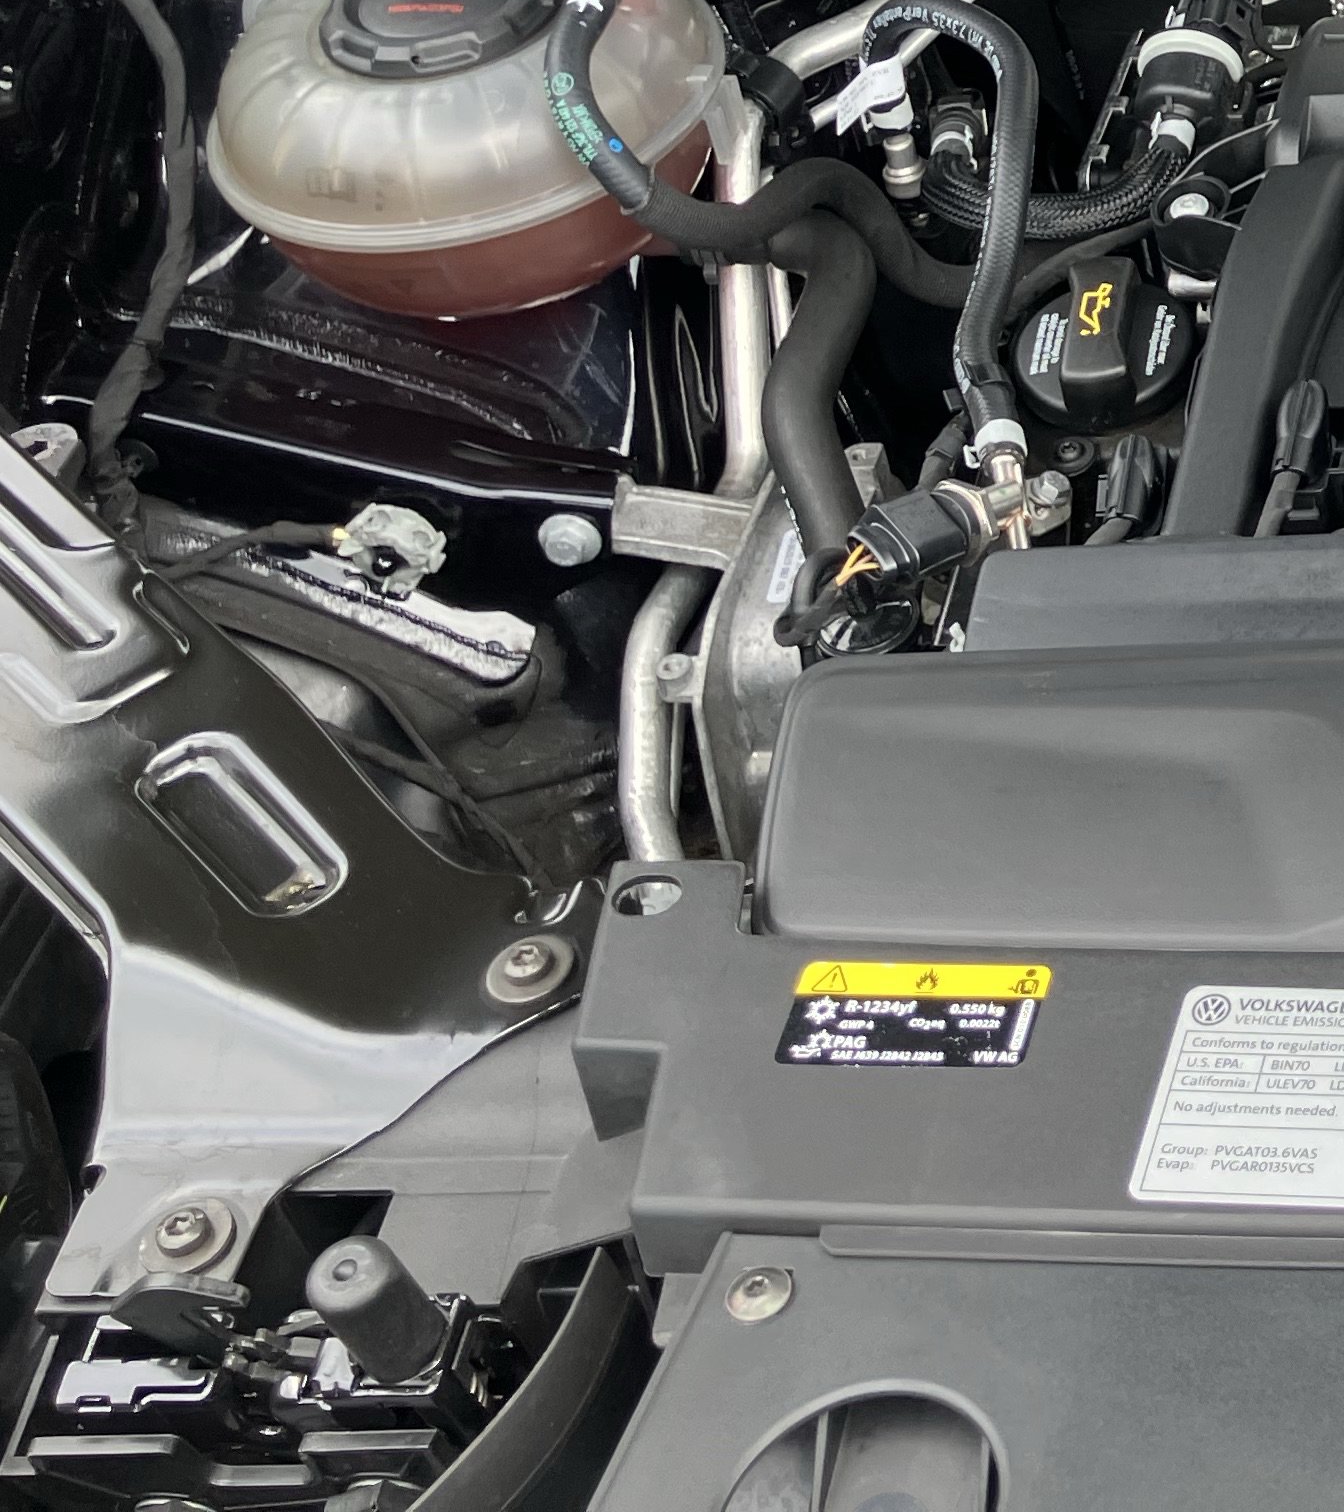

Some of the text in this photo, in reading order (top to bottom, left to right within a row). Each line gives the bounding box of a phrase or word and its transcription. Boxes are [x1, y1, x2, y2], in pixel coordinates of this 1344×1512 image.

[844, 999, 918, 1016] R-1234yf
[949, 1001, 1006, 1017] 0.550 kg
[1235, 1014, 1289, 1026] VEHICLE
[833, 1035, 867, 1048] PAG
[1192, 1037, 1256, 1049] Conforms
[1261, 1039, 1274, 1050] to
[973, 1051, 1018, 1064] VW AG
[1186, 1057, 1243, 1069] U.S. EPA:
[1270, 1060, 1311, 1071] BIN70
[1180, 1075, 1250, 1088] California:
[1266, 1078, 1316, 1089] ULEV70
[1173, 1100, 1338, 1117] No adjustments needed.
[1160, 1143, 1318, 1159] Group: PVGAT03.6VAS
[1157, 1158, 1195, 1172] Evap:
